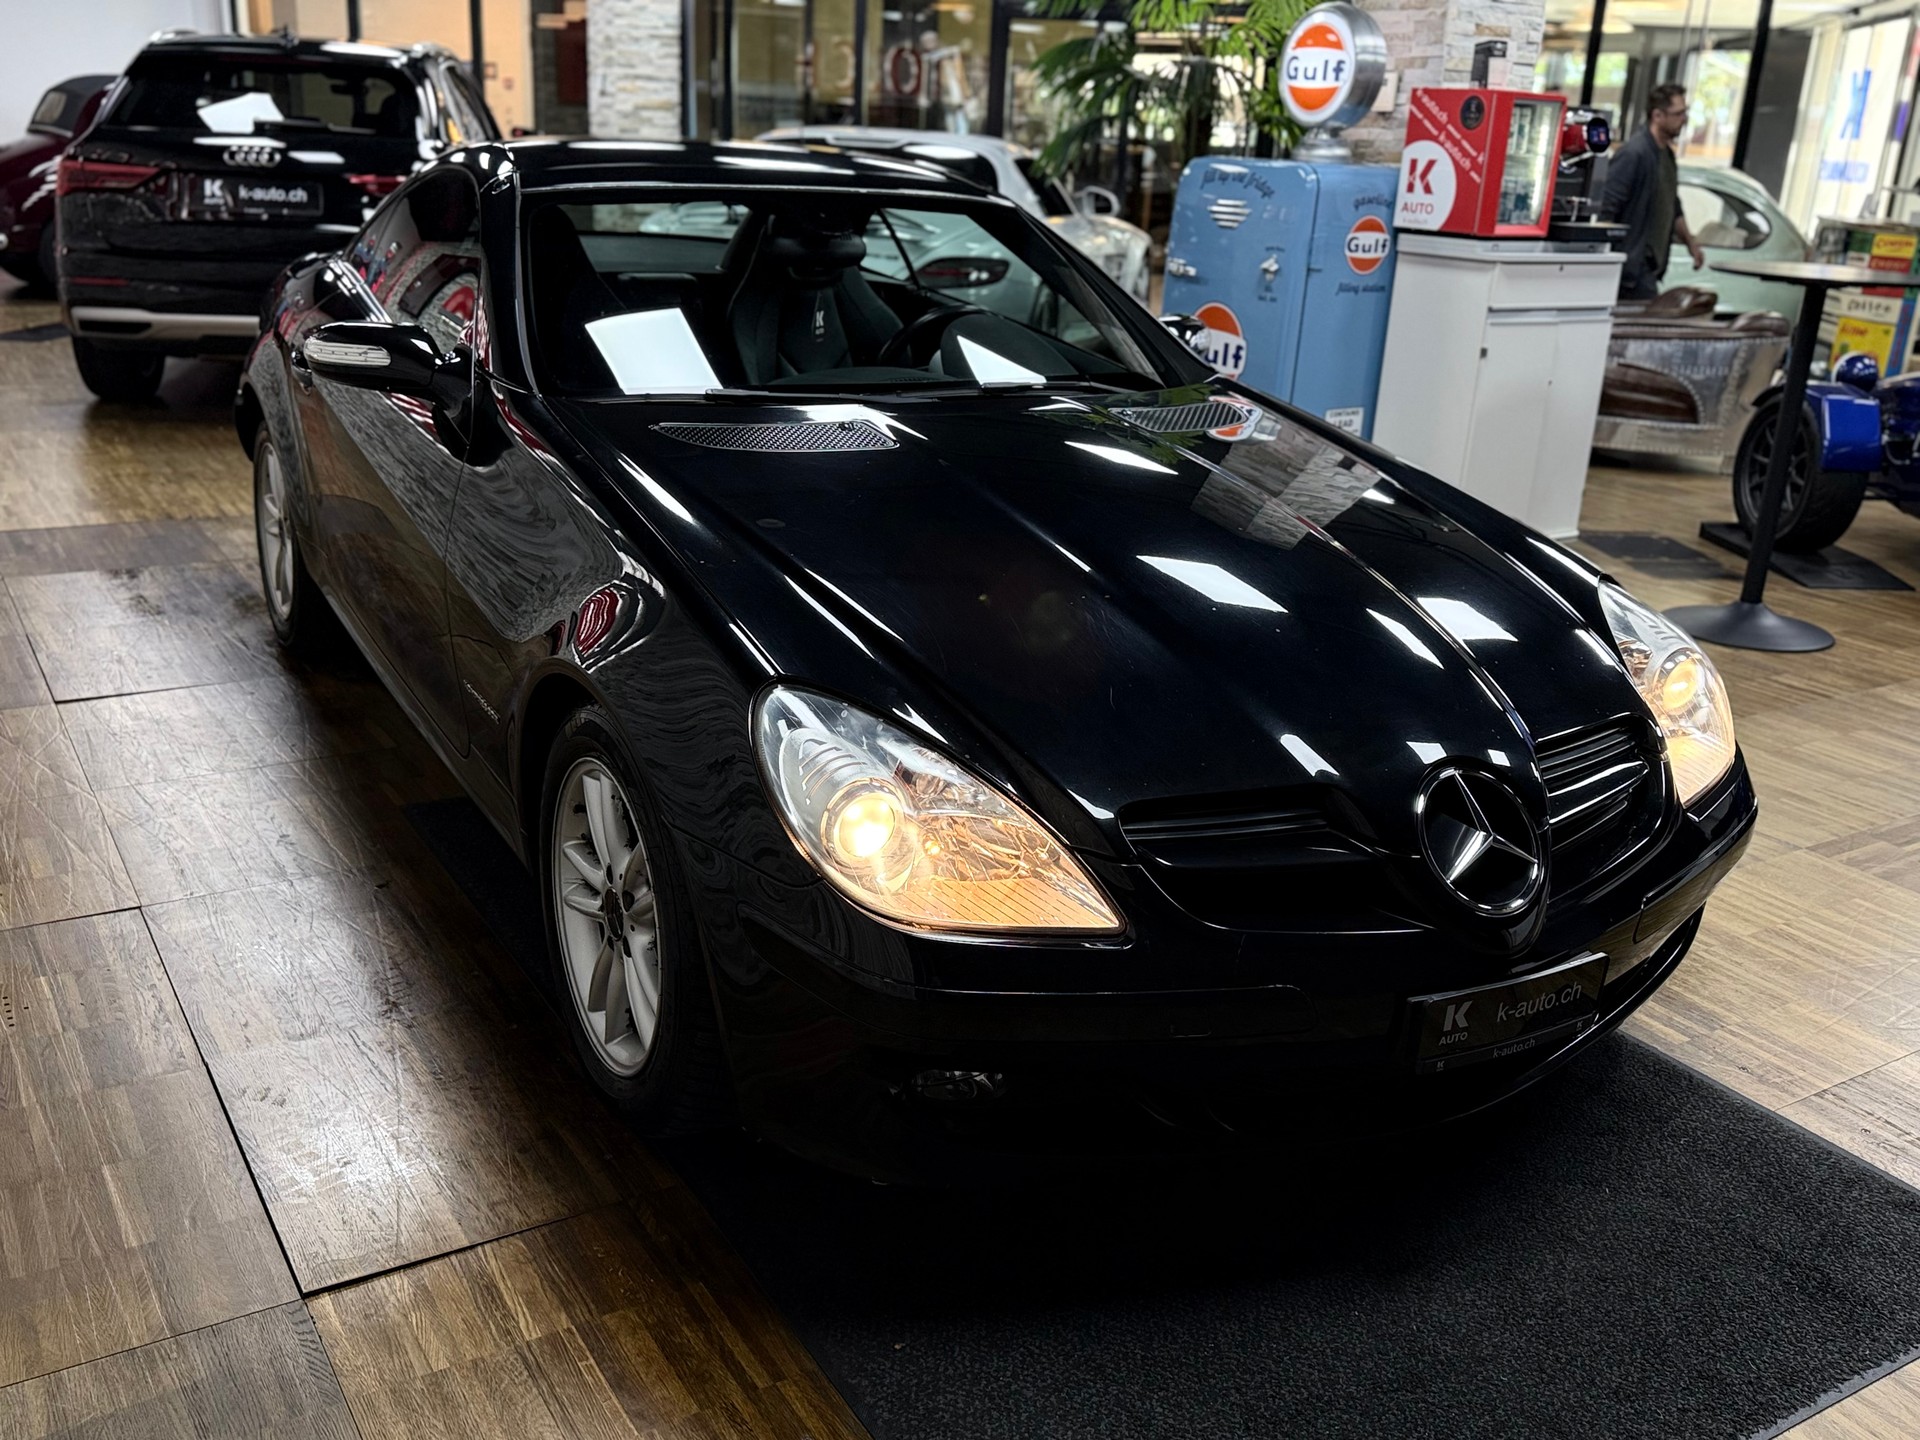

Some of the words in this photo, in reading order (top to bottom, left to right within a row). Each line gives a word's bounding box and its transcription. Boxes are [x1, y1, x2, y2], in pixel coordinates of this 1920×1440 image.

[1286, 56, 1346, 81] Gulf
[1406, 158, 1438, 195] K
[203, 178, 223, 197] K
[238, 184, 308, 203] k-auto.ch
[1401, 202, 1434, 215] AUTO
[1347, 236, 1388, 254] Gulf
[815, 310, 825, 327] K
[1204, 343, 1244, 369] ulf
[1496, 981, 1582, 1022] k-auto.ch
[1443, 1000, 1473, 1032] K
[1438, 1031, 1468, 1046] AUTO
[1492, 1038, 1536, 1058] k-auto.ch
